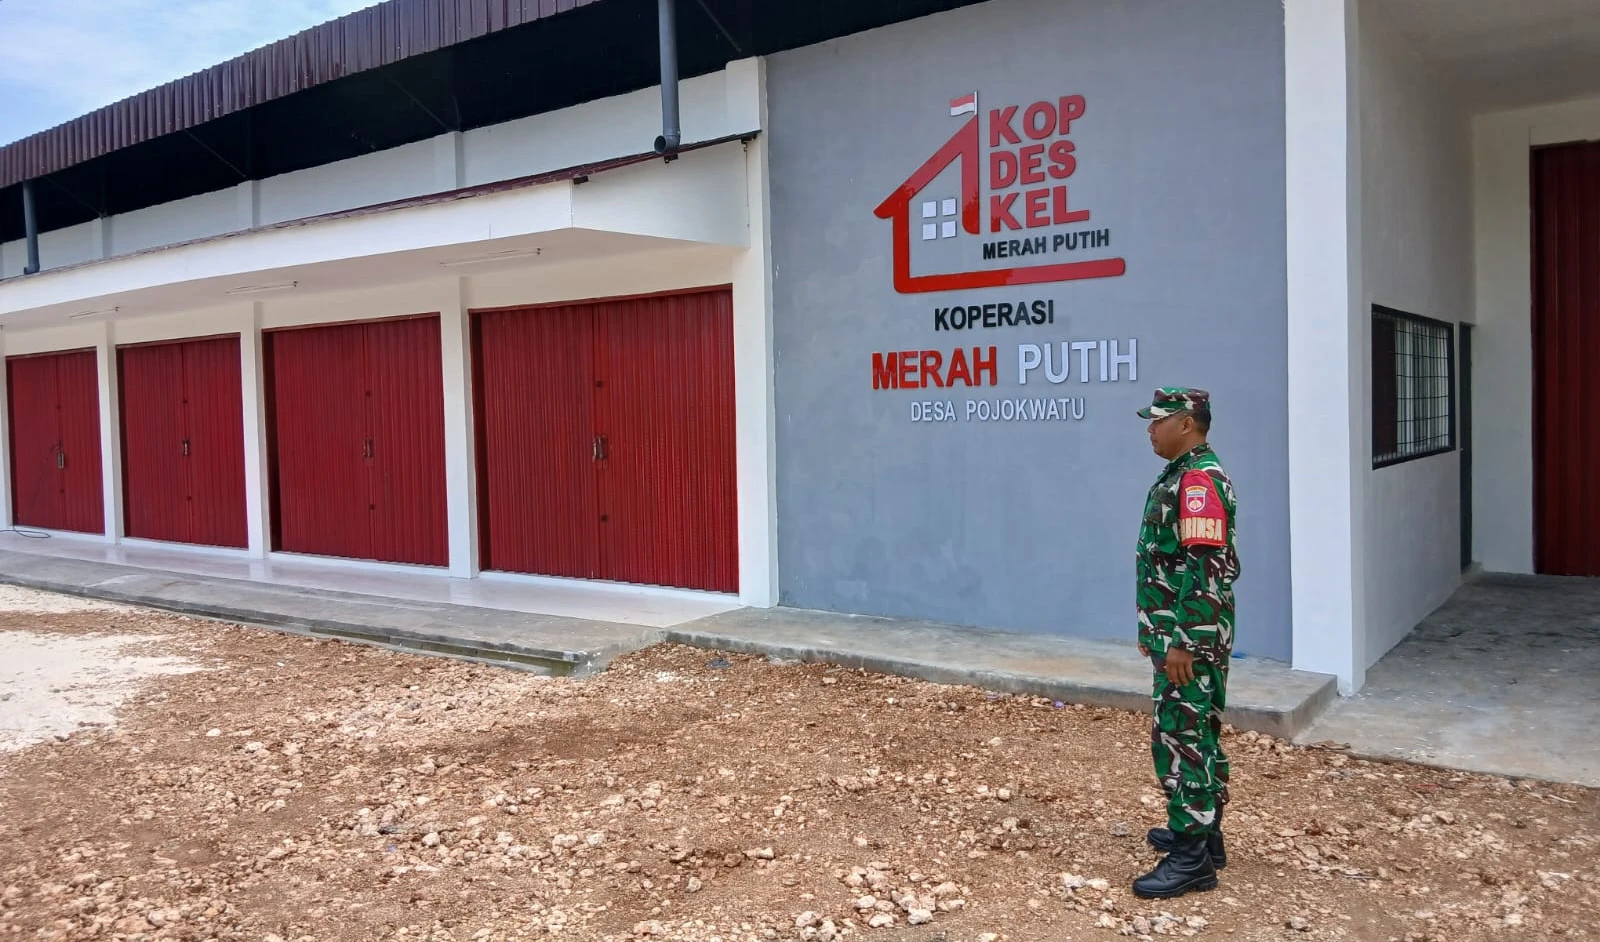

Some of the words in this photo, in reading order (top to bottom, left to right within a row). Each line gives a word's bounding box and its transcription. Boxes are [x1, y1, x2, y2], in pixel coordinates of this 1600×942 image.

[989, 94, 1086, 147] KOP
[990, 140, 1076, 189] DES
[990, 185, 1090, 233] KEL
[983, 236, 1047, 260] MERAH
[1053, 229, 1109, 253] PUTIH
[934, 300, 1054, 330] KOPERASI
[872, 346, 997, 390] MERAH
[1018, 338, 1138, 384] PUTIH
[911, 400, 956, 422] DESA
[967, 398, 1085, 421] POJOKWATU
